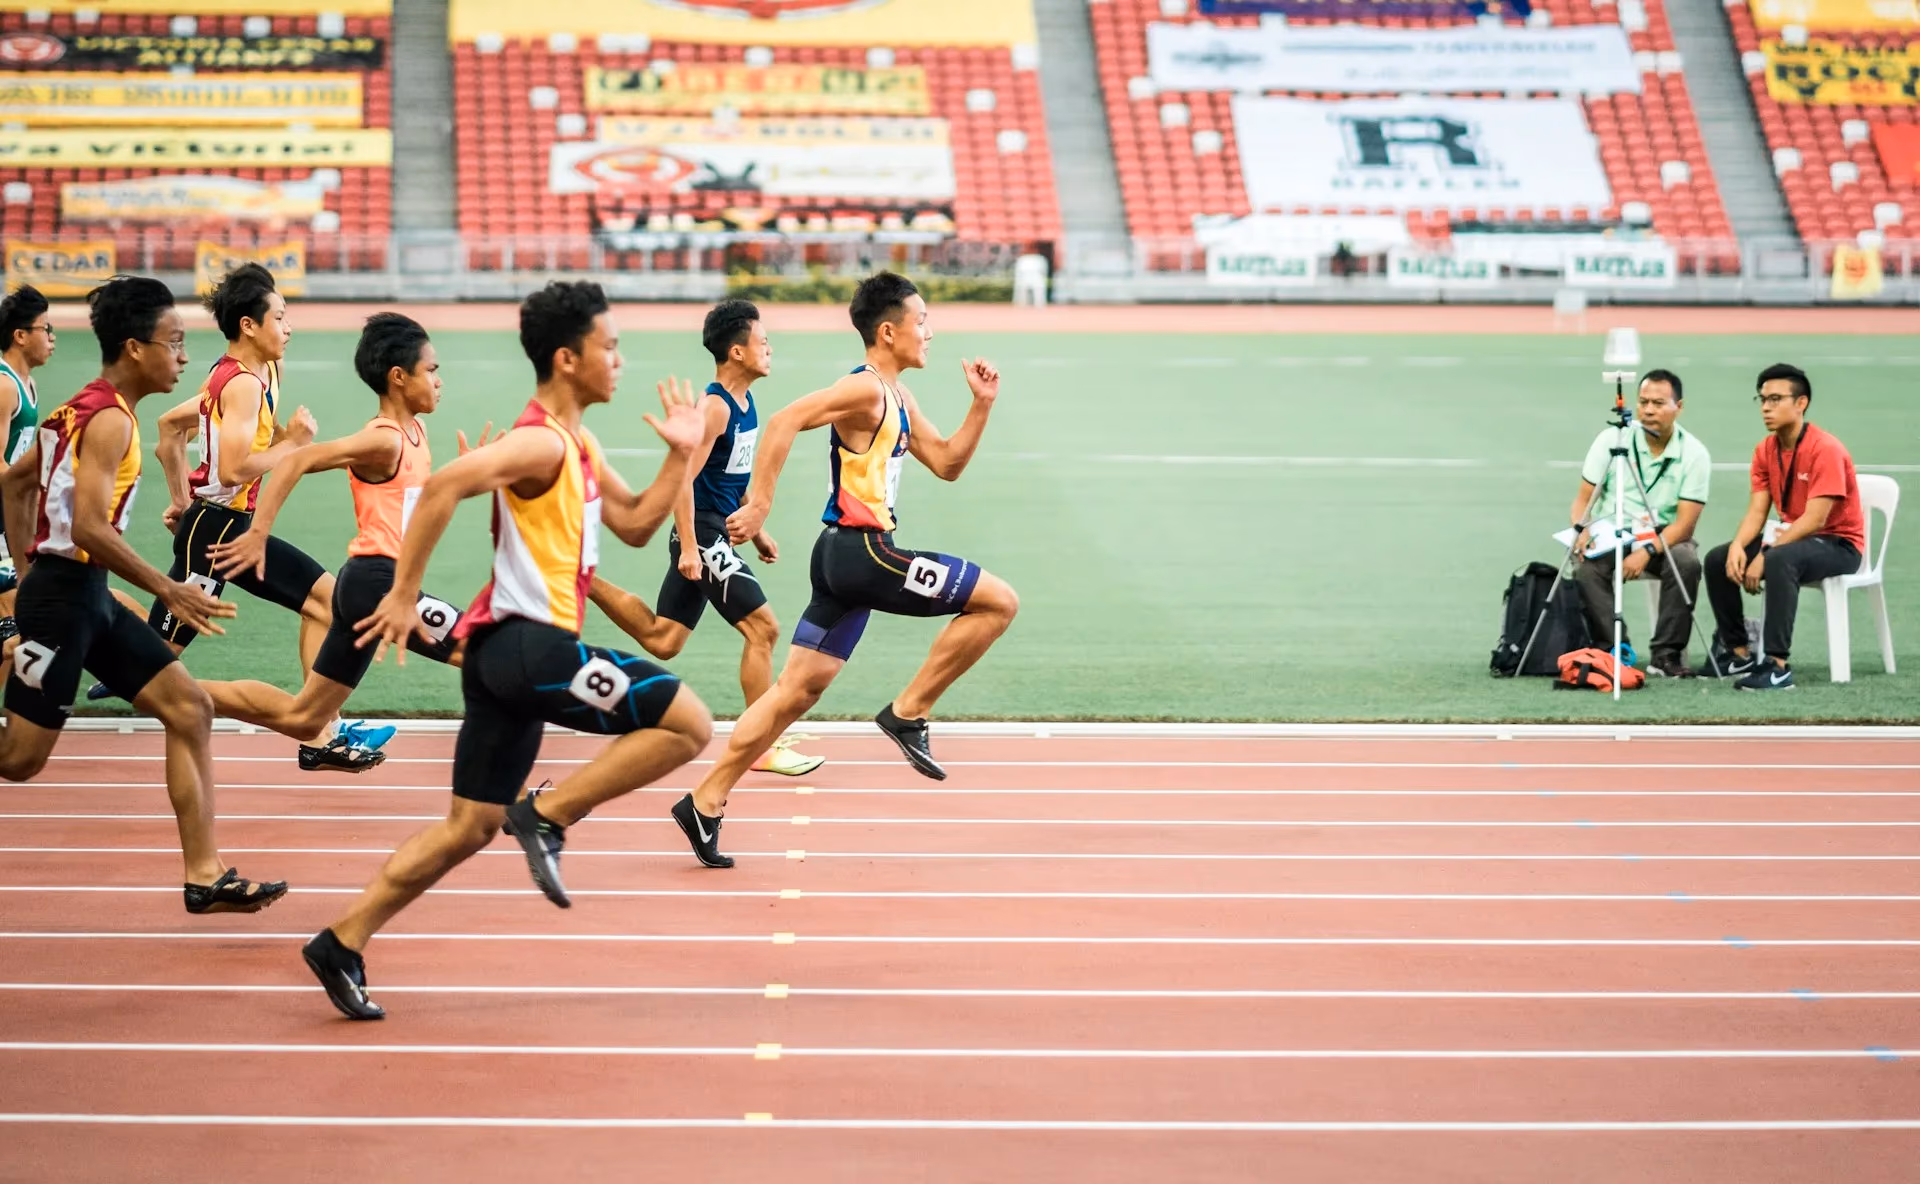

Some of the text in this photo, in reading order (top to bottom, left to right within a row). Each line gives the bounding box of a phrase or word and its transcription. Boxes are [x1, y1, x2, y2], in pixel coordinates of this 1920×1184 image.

[711, 550, 733, 574] 2
[913, 565, 938, 589] 5
[421, 606, 446, 628] 6
[22, 647, 43, 676] 7
[585, 670, 616, 698] 8
